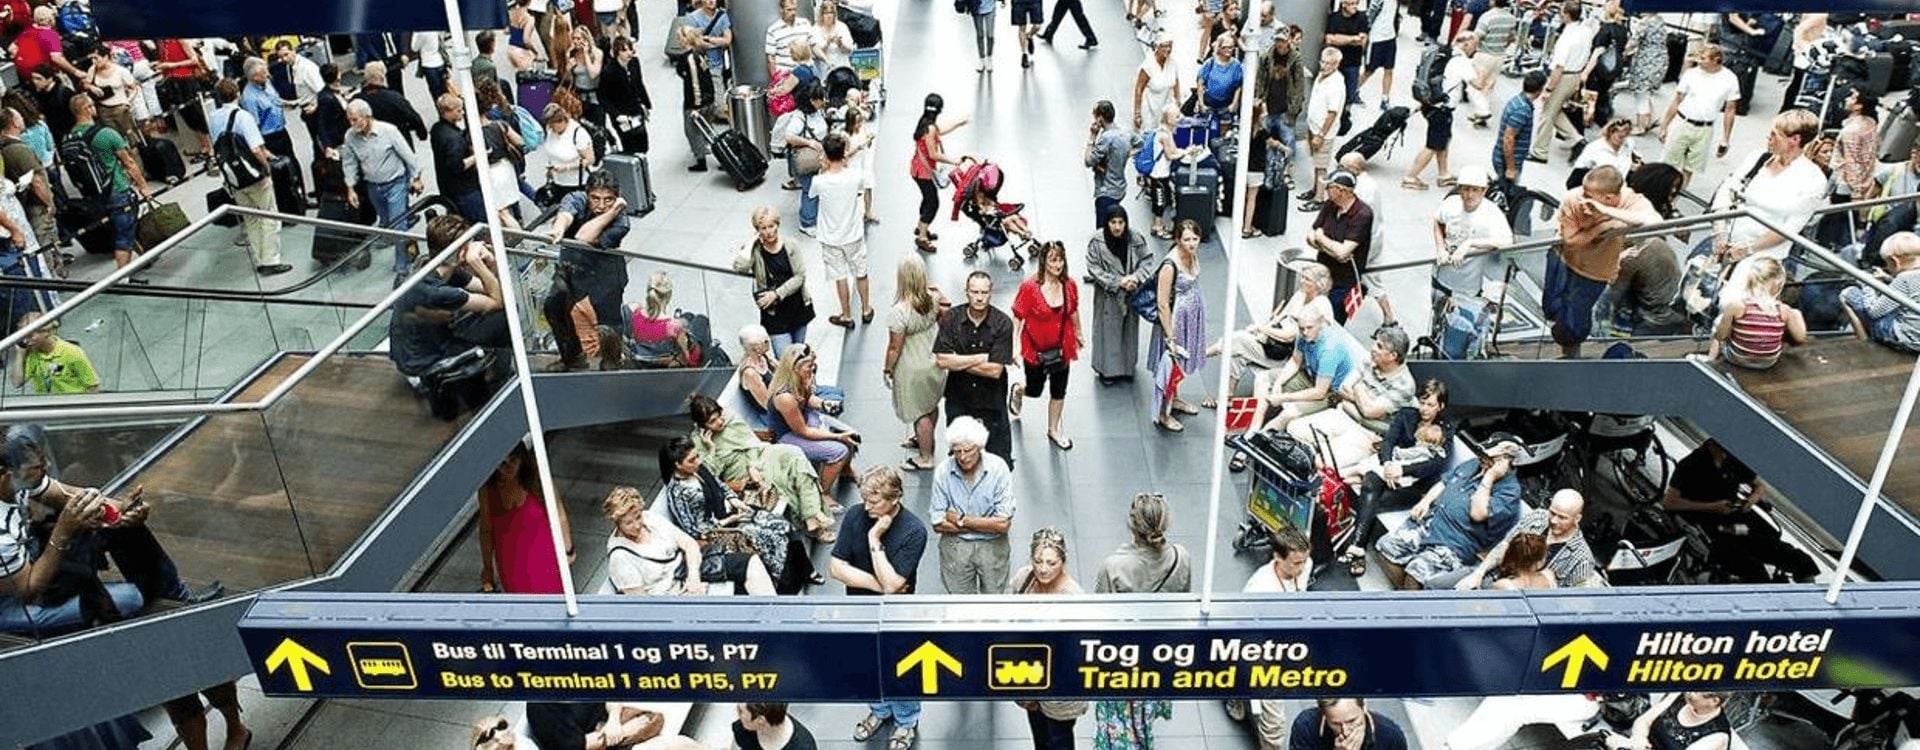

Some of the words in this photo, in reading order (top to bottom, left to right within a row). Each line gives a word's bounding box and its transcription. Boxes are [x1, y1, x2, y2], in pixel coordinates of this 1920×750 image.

[433, 643, 477, 659] Bus
[482, 643, 505, 659] til
[509, 644, 608, 660] Terminal
[614, 644, 624, 659] 1
[632, 648, 661, 663] og
[669, 644, 714, 662] P15,
[723, 644, 758, 660] P17
[1080, 640, 1139, 667] Tog
[1153, 644, 1194, 666] og
[1210, 639, 1308, 662] Metro
[1636, 632, 1734, 655] Hilton
[1745, 629, 1832, 653] hotel
[1079, 667, 1160, 688] Train
[1173, 667, 1236, 688] and
[1250, 666, 1347, 687] Metro
[1627, 660, 1723, 681] Hilton
[1735, 657, 1821, 679] hotel
[441, 672, 485, 688] Bus
[490, 673, 513, 688] to
[517, 673, 615, 688] Terminal
[621, 673, 631, 688] 1
[639, 674, 681, 689] and
[689, 673, 734, 690] P15,
[742, 673, 777, 689] P17
